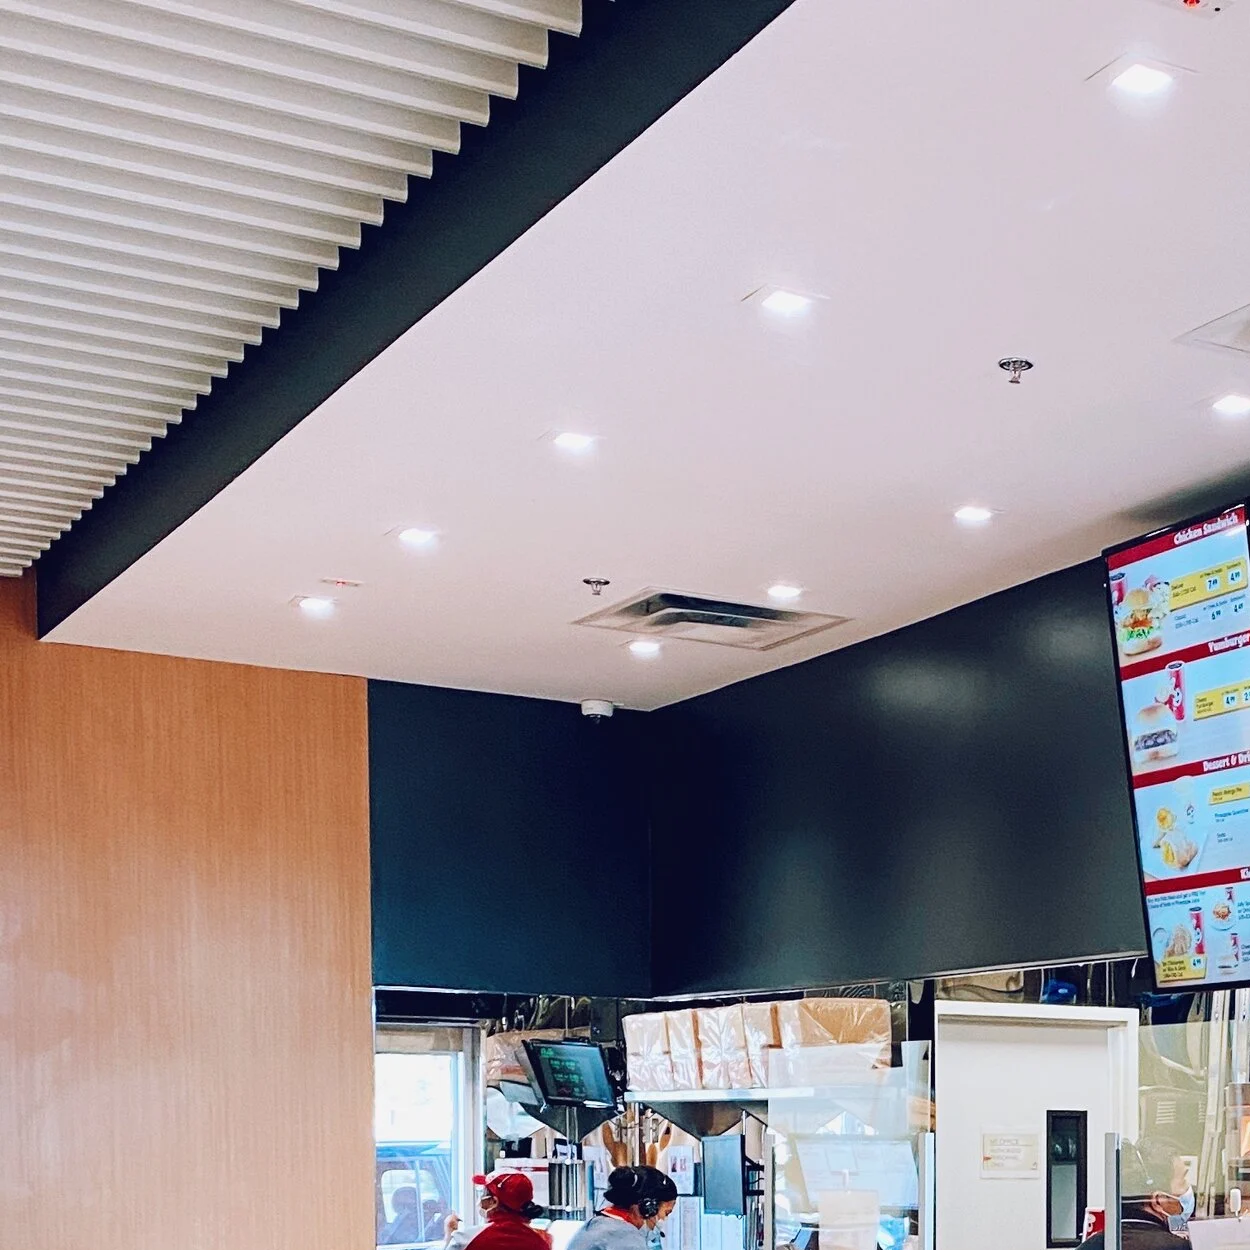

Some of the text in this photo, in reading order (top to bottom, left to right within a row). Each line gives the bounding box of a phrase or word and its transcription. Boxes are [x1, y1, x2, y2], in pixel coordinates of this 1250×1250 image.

[1174, 512, 1238, 545] Chicken Sandwich
[1203, 757, 1230, 773] Dessert
